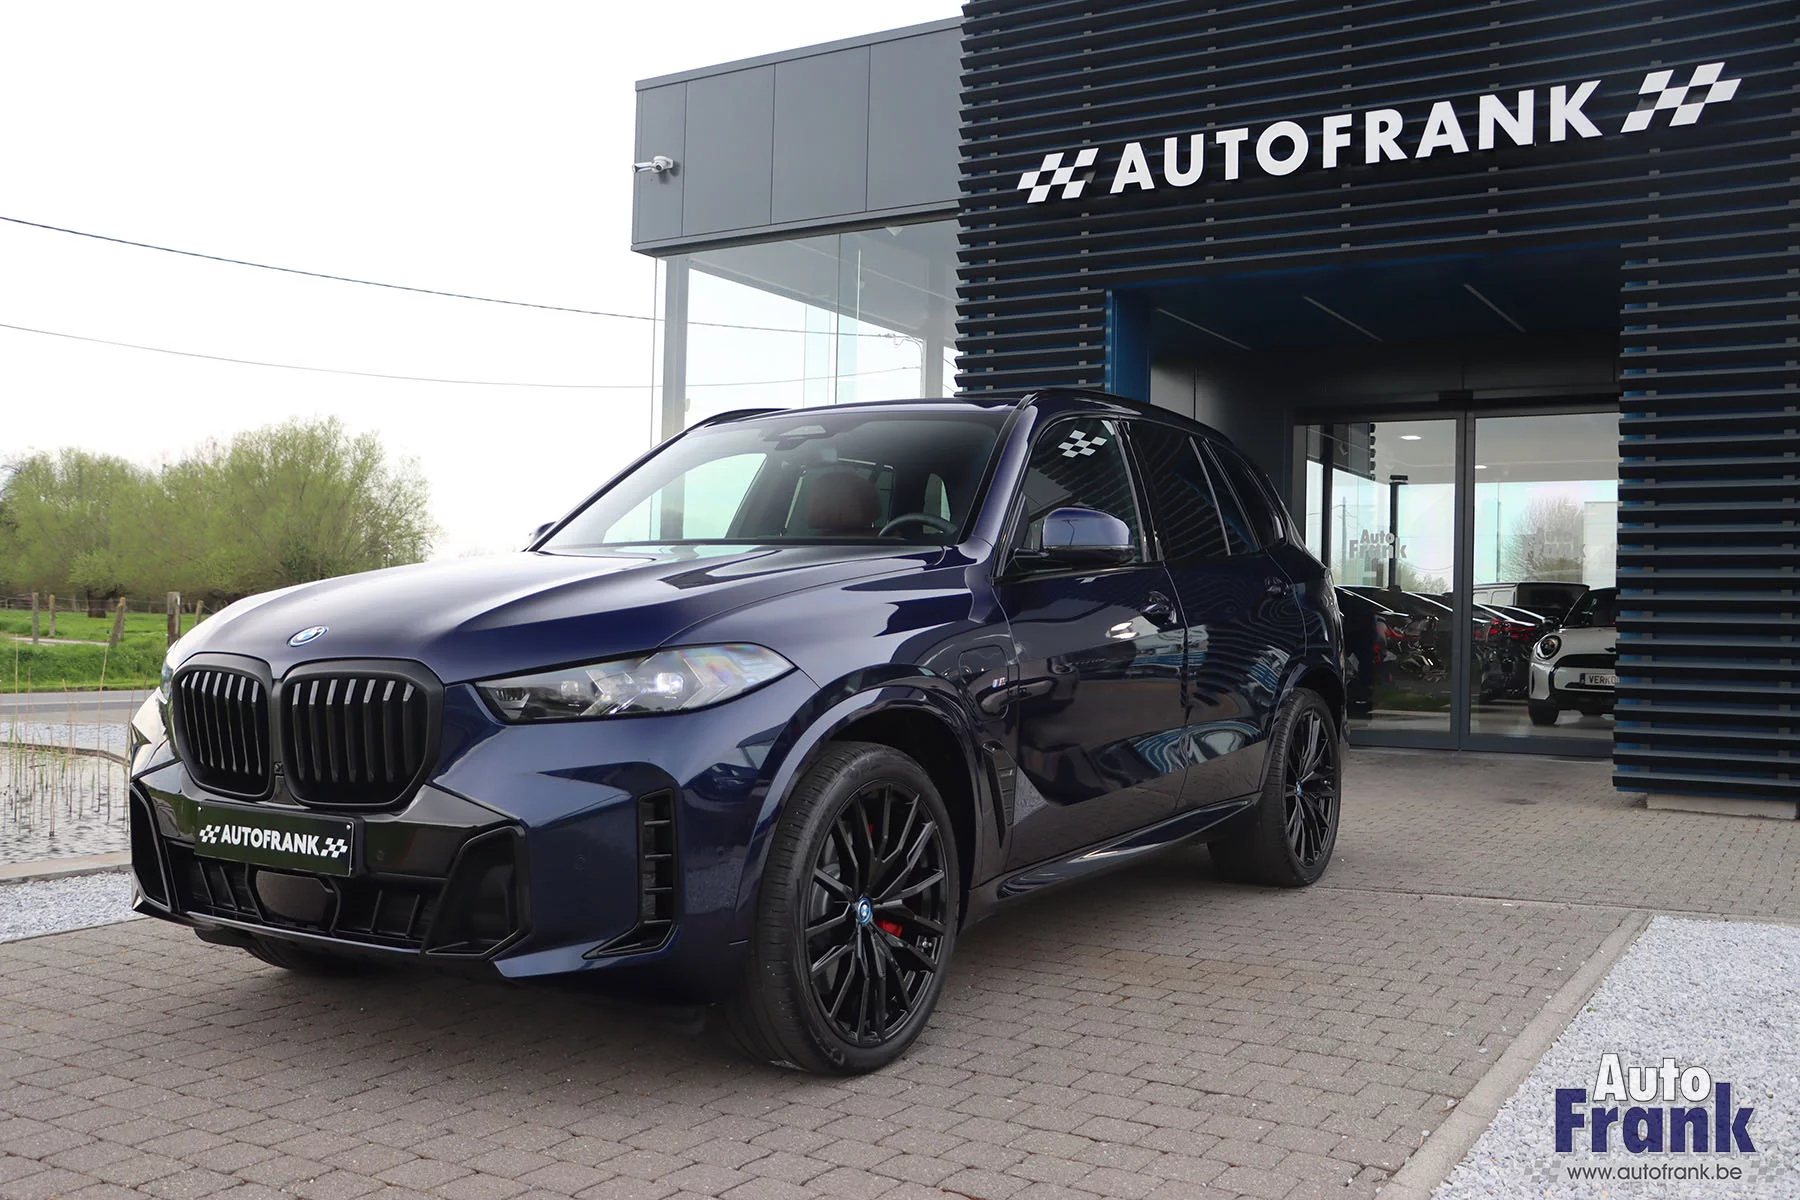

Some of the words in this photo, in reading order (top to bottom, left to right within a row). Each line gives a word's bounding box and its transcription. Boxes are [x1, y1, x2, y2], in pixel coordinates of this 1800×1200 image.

[1109, 79, 1603, 194] AUTOFRANK
[1349, 537, 1408, 559] Frank
[1360, 529, 1395, 544] Auto
[220, 824, 320, 856] AUTOFRANK
